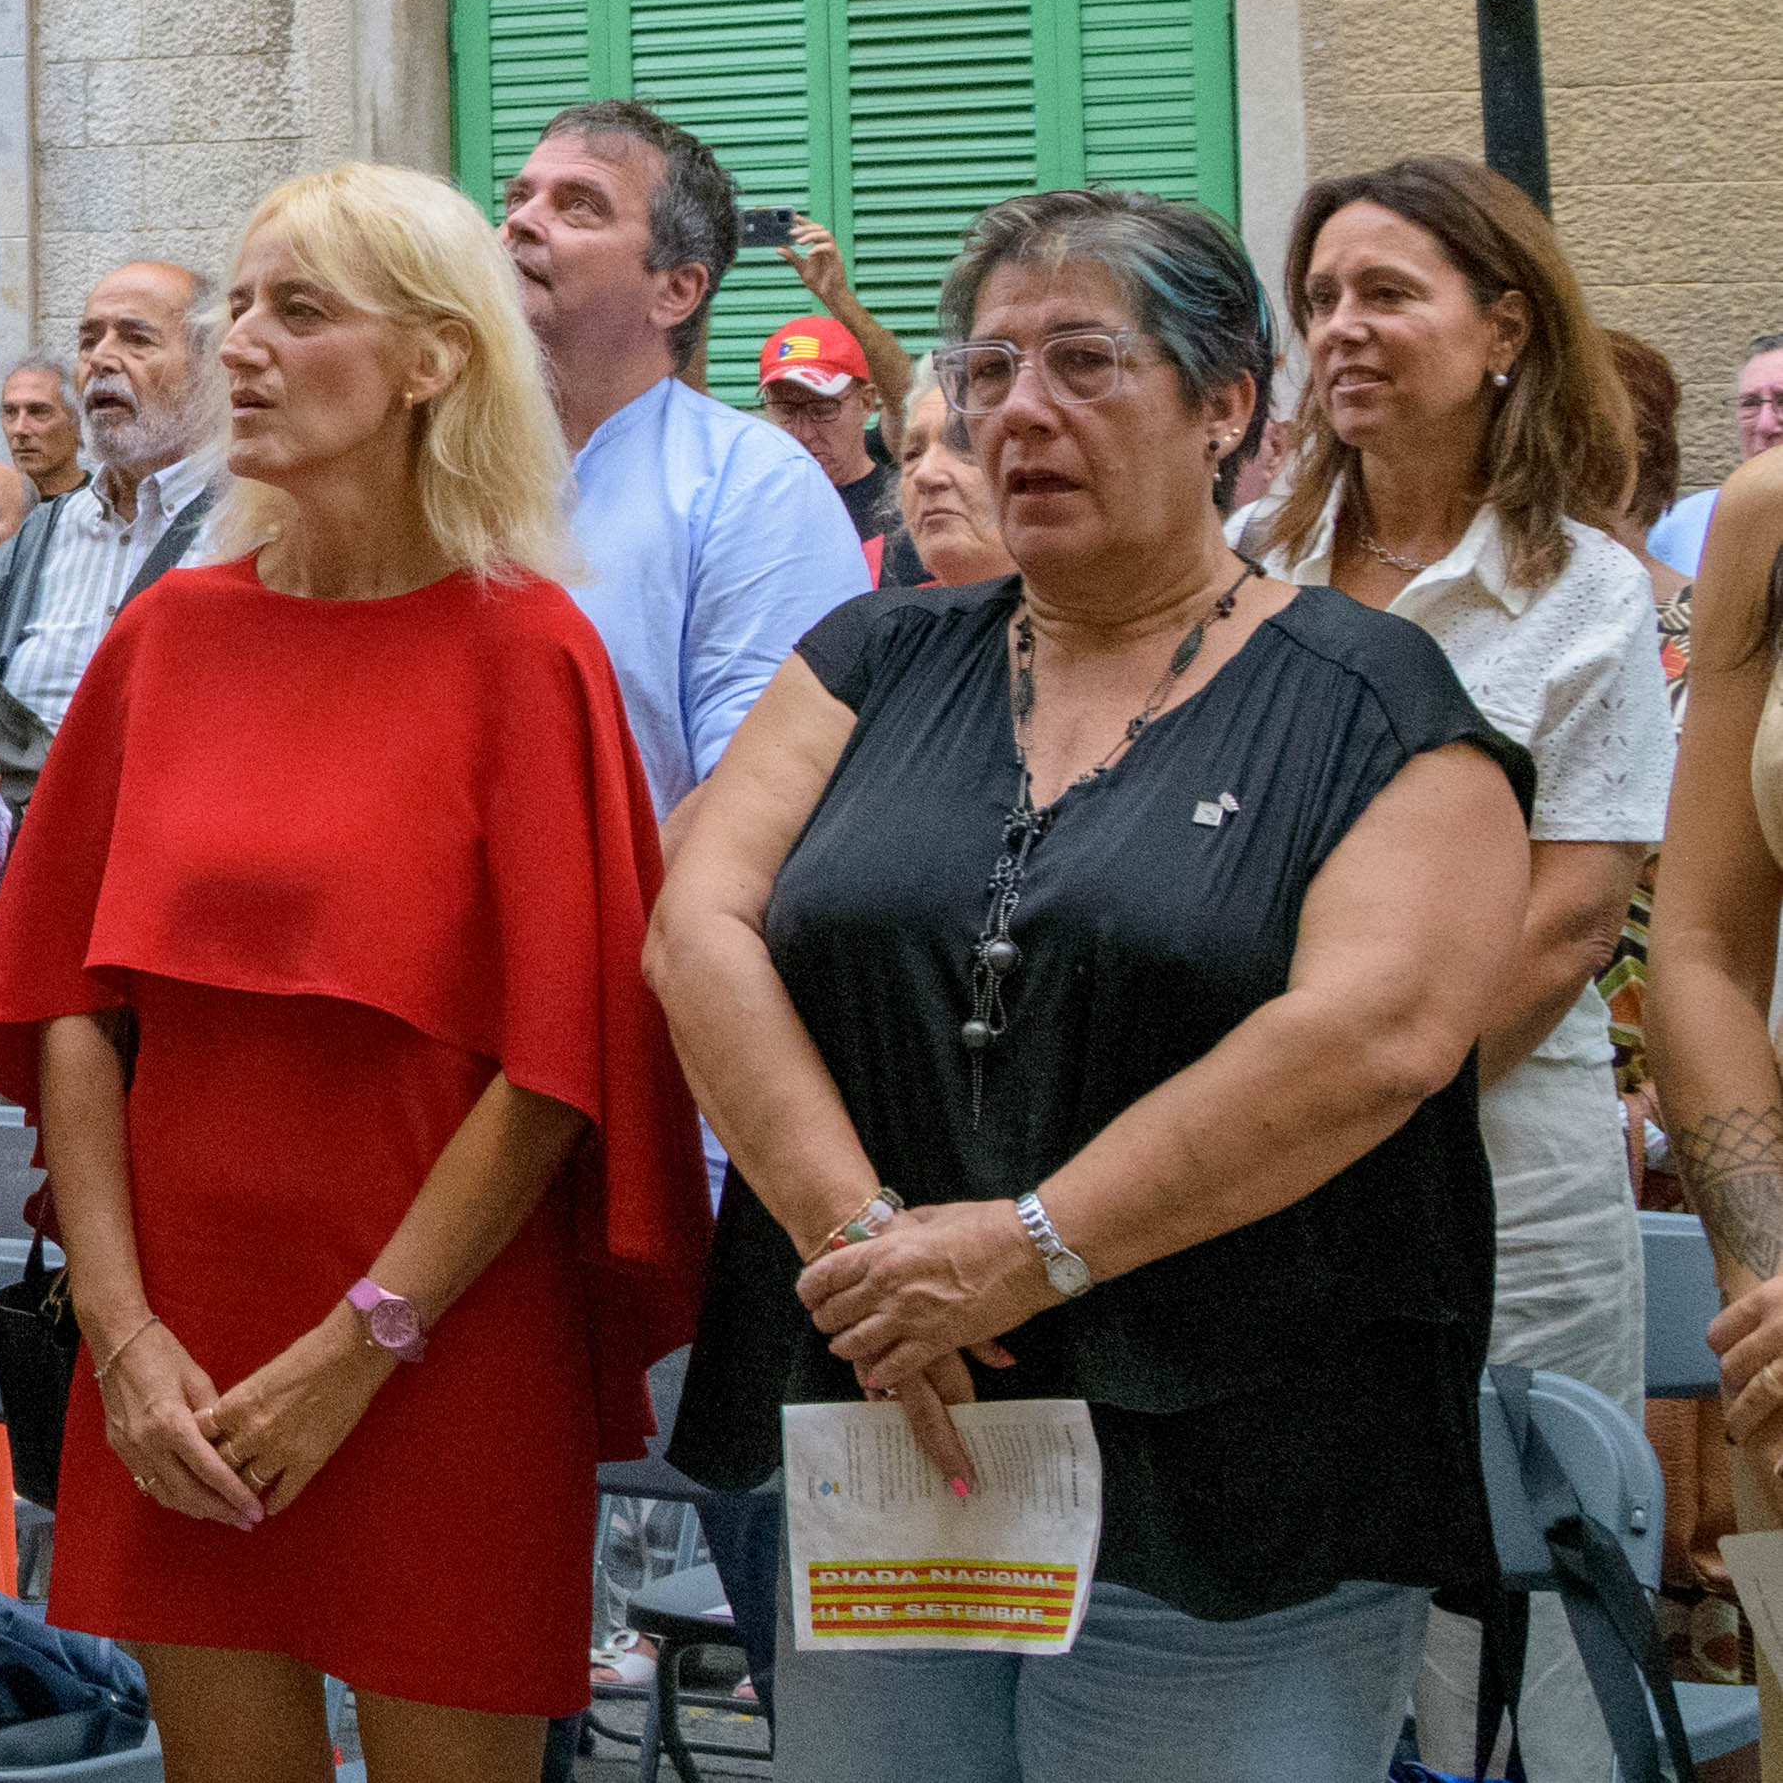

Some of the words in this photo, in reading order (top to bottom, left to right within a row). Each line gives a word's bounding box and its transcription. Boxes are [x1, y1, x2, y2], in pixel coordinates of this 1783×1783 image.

[817, 1569, 918, 1585] DIADA
[930, 1568, 1059, 1588] NACIONAL
[818, 1607, 838, 1621] 11
[851, 1604, 893, 1619] DE
[905, 1603, 1044, 1623] SETEMBRE
